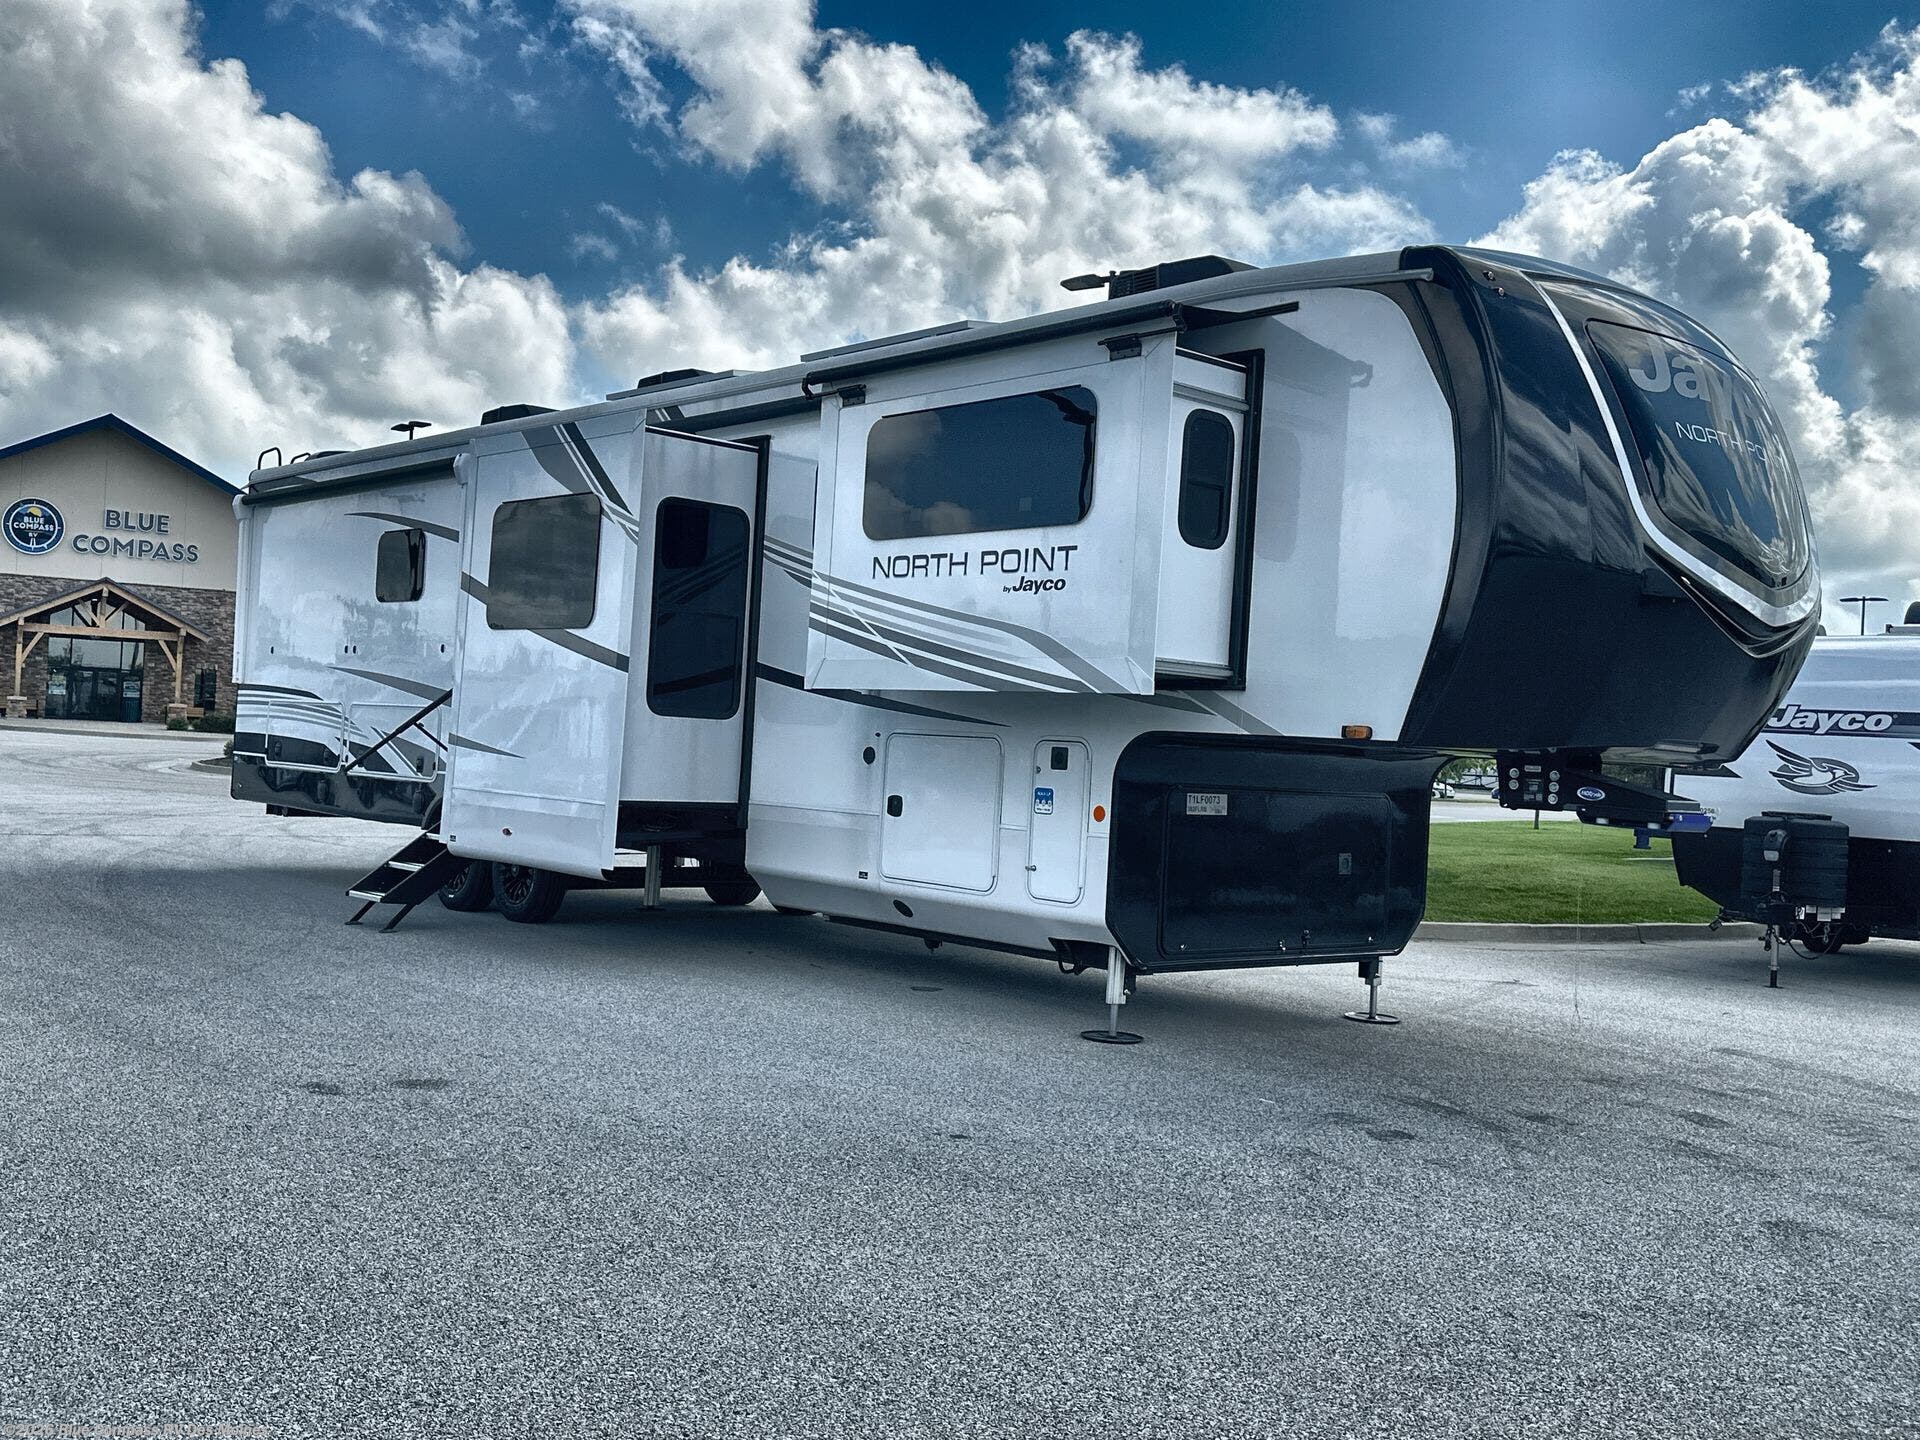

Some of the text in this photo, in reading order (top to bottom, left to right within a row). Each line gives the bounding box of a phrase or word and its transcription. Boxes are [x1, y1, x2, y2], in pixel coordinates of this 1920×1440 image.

[1674, 420, 1743, 453] NORTH
[13, 521, 55, 531] COMPASS
[23, 516, 45, 524] BLUE
[105, 509, 170, 534] BLUE
[72, 534, 200, 563] COMPASS
[872, 545, 1078, 579] NORTH POINT
[1002, 576, 1067, 595] by Jayco
[1767, 704, 1893, 735] Jayco
